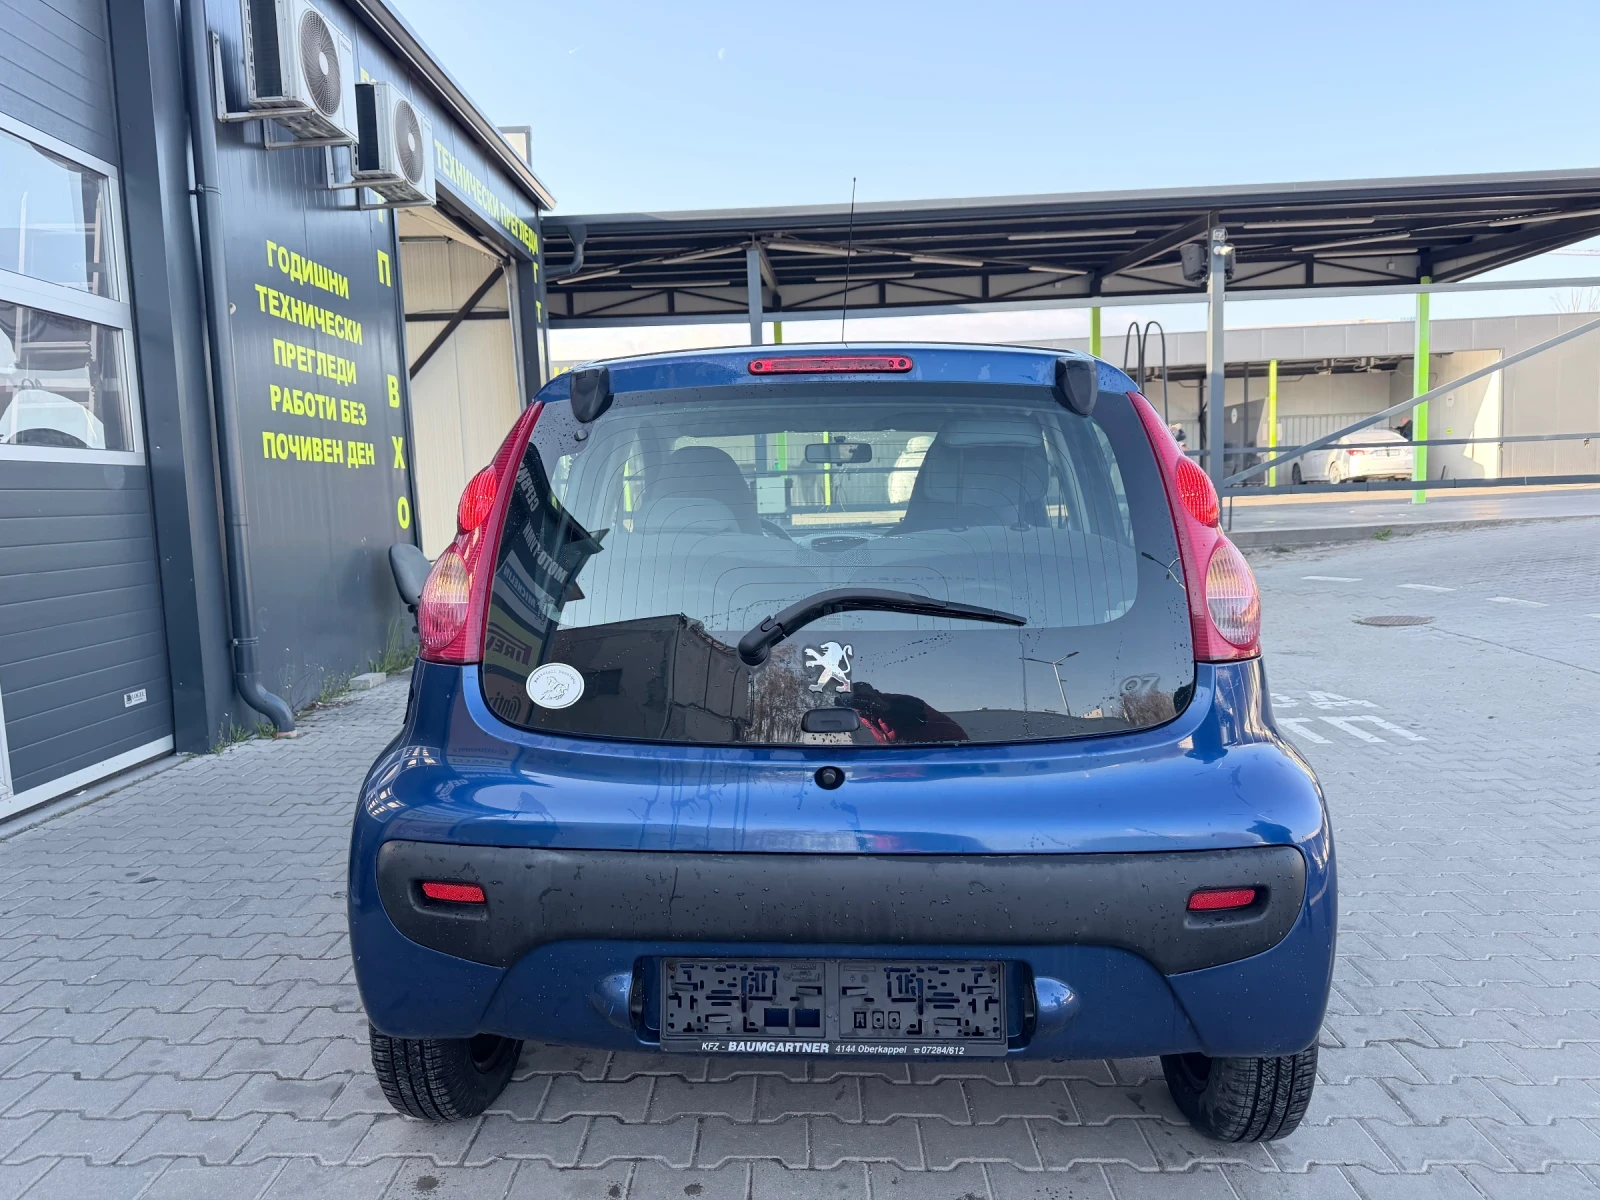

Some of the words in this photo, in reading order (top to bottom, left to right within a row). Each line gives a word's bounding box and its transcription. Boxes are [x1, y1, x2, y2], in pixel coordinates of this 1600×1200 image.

[434, 139, 499, 221] ТЕХНИЧЕСКИ
[500, 202, 538, 255] ПРЕГЛЕДИ
[266, 240, 349, 299] ГОДИШНИ
[255, 284, 362, 345] ТЕХНИЧЕСКИ
[273, 338, 356, 386] ПРЕГЛЕДИ
[269, 384, 337, 421] РАБОТИ
[340, 399, 367, 426] БЕЗ
[262, 431, 343, 464] ПОЧИВЕН
[347, 441, 375, 468] ДЕН
[701, 1042, 719, 1051] KFZ
[728, 1041, 829, 1053] BAUMGARTNER
[835, 1045, 856, 1053] 4144
[857, 1045, 908, 1055] Oberkappel
[921, 1046, 965, 1055] 07284/612
